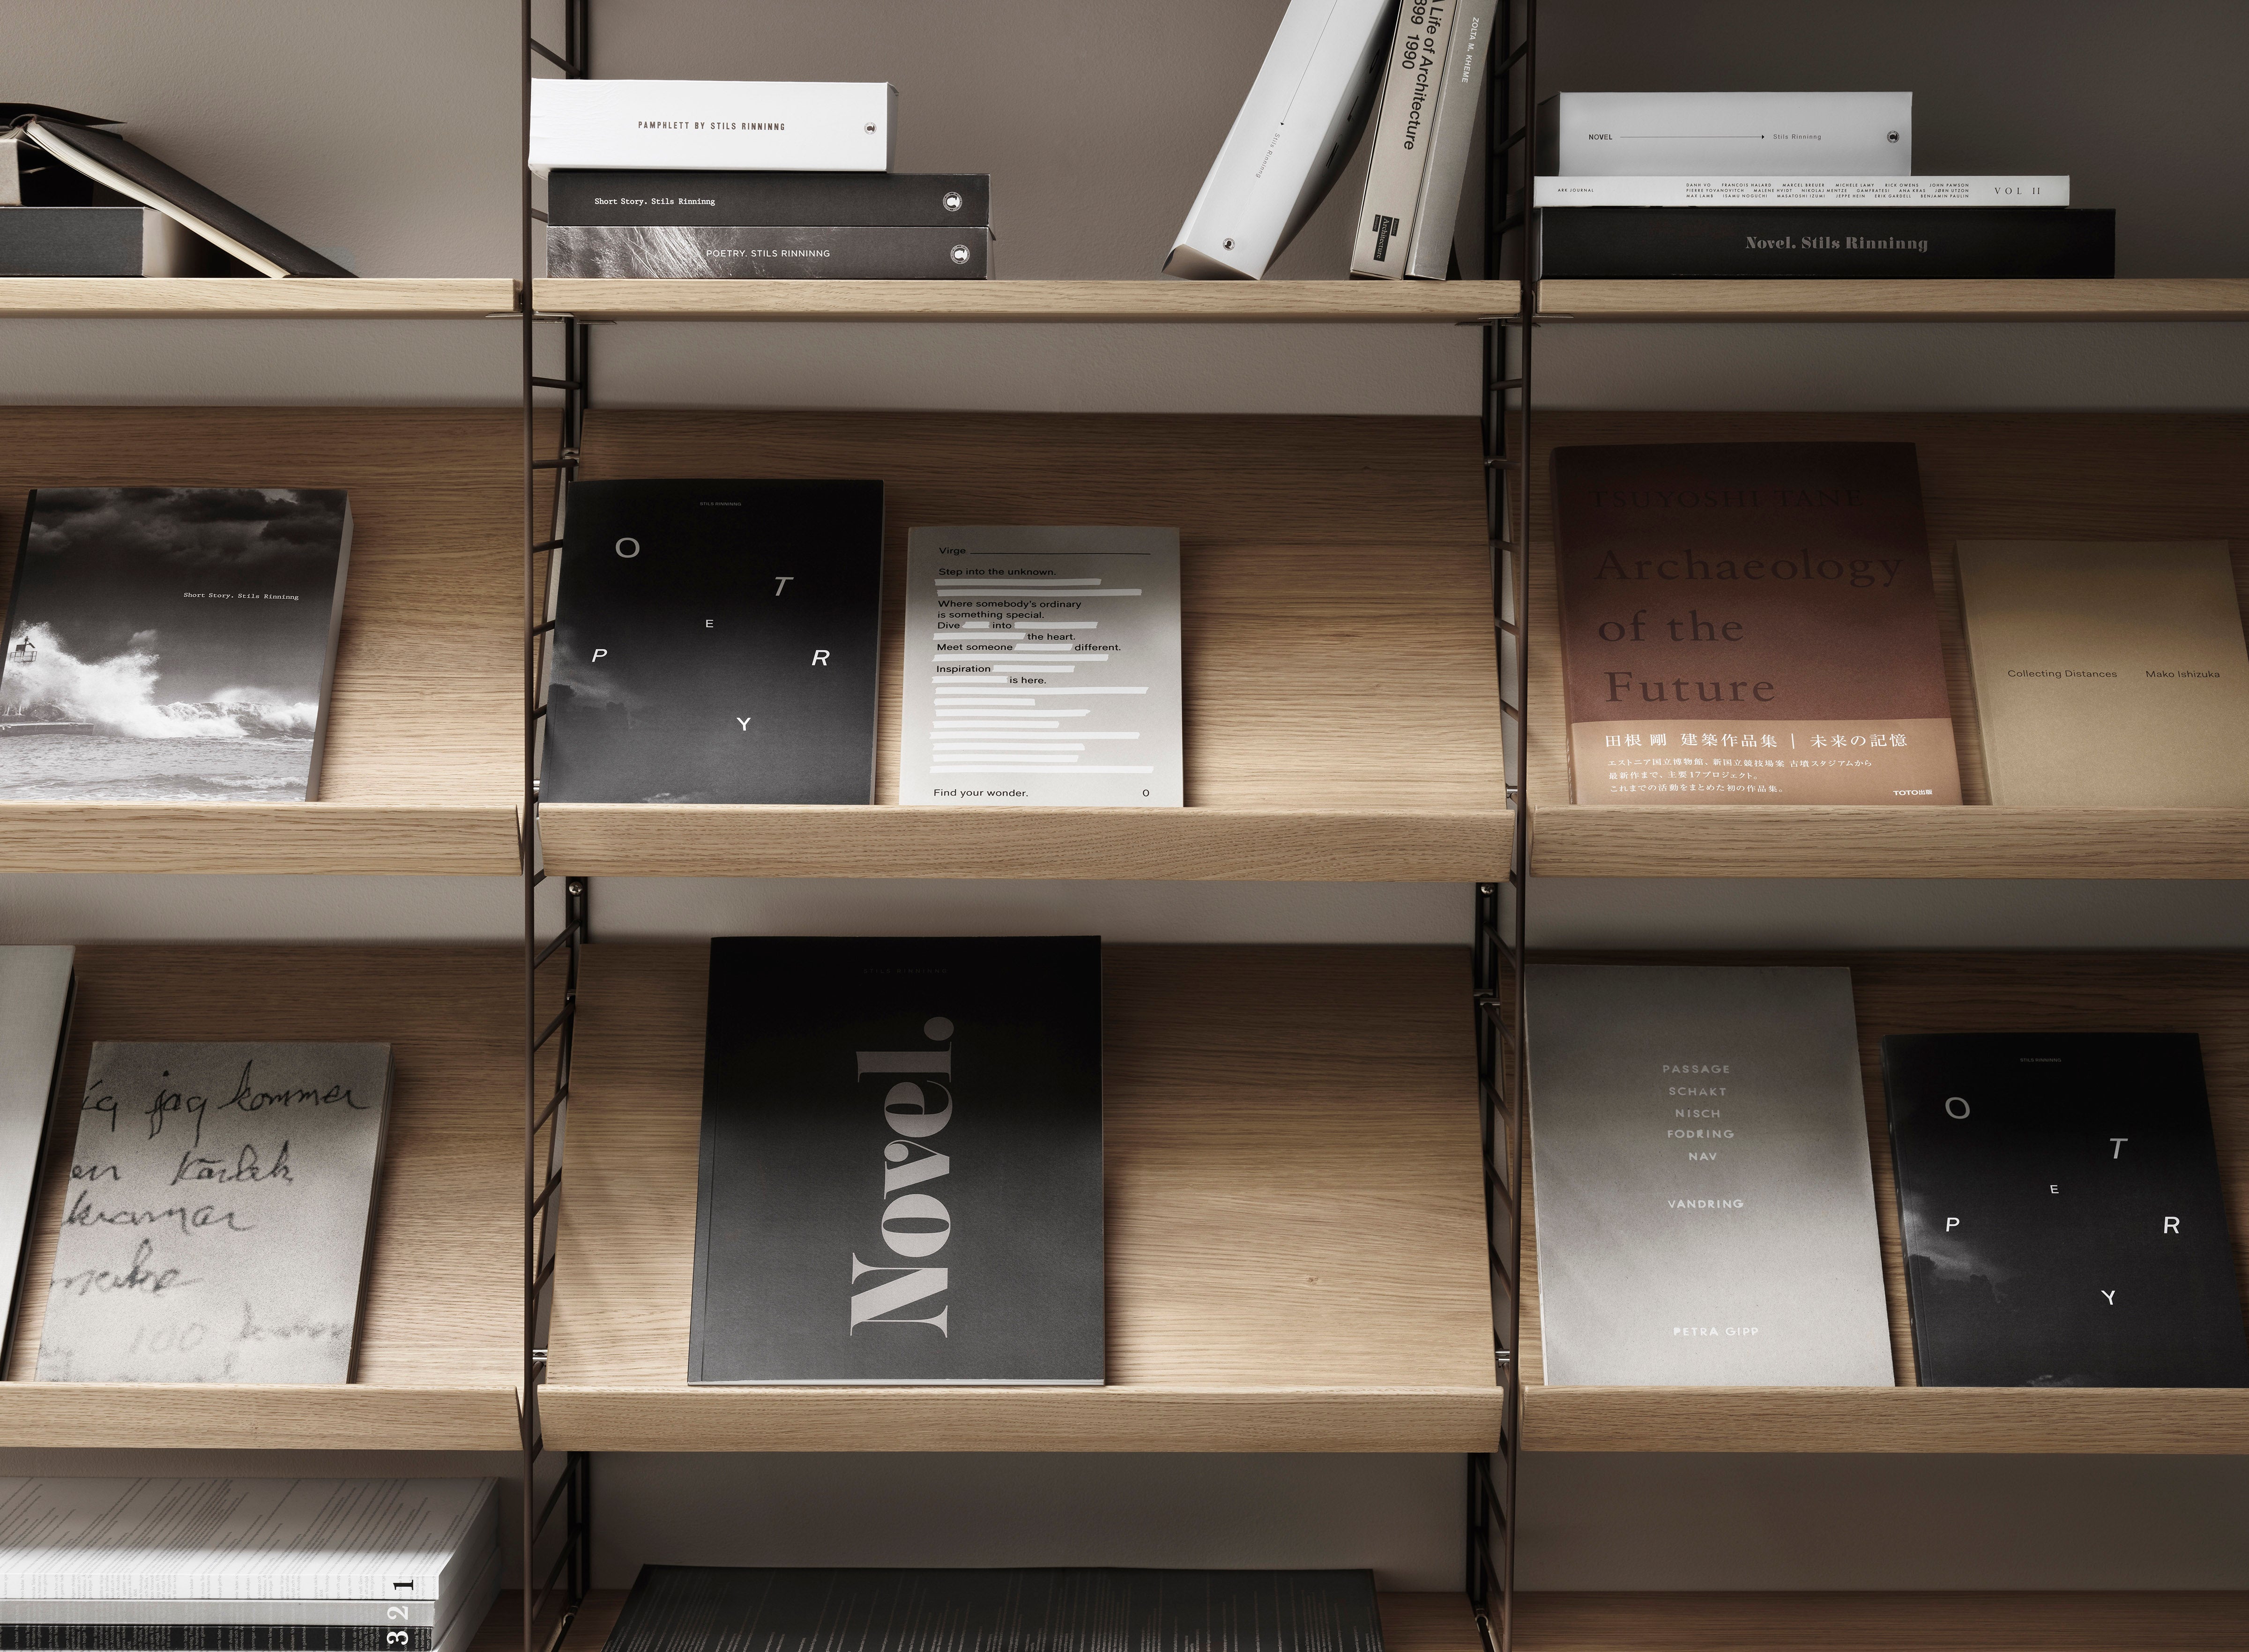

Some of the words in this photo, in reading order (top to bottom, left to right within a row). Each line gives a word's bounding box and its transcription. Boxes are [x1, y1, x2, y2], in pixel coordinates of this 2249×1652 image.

[1426, 7, 1444, 35] Life
[1469, 16, 1480, 41] ZOLTA
[1402, 34, 1420, 69] 1990
[1422, 37, 1436, 54] of
[1467, 43, 1475, 52] M.
[1461, 54, 1473, 84] KHEME
[1403, 55, 1434, 151] Architecture
[638, 121, 689, 129] PAMPHLETT
[742, 122, 784, 131] RINNINNG
[1269, 133, 1281, 148] Stils
[1255, 150, 1273, 179] Rinninng
[621, 198, 648, 206] Story.
[678, 198, 715, 206] Rinninng
[1376, 218, 1390, 259] Architecture
[1745, 236, 1796, 249] Novel.
[1802, 236, 1840, 249] Stils
[1846, 237, 1928, 253] Rinninng
[706, 249, 748, 257] POETRY.
[751, 249, 777, 258] STILS
[781, 249, 830, 258] RINNINNG
[615, 537, 640, 558] O
[939, 547, 966, 556] Virge
[938, 568, 962, 577] Step
[1593, 548, 1905, 588] Archaeology
[775, 576, 794, 596] T
[976, 600, 1037, 610] somebody's
[1040, 601, 1081, 610] ordinary
[949, 611, 1003, 620] something
[1006, 611, 1044, 620] special.
[706, 619, 714, 628] E
[1598, 609, 1647, 642] of
[1666, 609, 1744, 642] the
[592, 648, 608, 662] P
[812, 649, 830, 666] R
[937, 665, 990, 674] Inspiration
[2008, 670, 2062, 679] Collecting
[1603, 671, 1776, 703] Future
[736, 717, 751, 731] Y
[1680, 733, 1778, 748] 建築作品集
[1810, 733, 1908, 748] 未来の記憶
[1663, 1065, 1729, 1073] PASSAGE
[217, 1059, 372, 1112] kommer
[1669, 1086, 1726, 1096] SCHAKT
[1676, 1109, 1720, 1118] NISCH
[1945, 1097, 1970, 1119] O
[2109, 1138, 2129, 1159] T
[1689, 1152, 1717, 1161] NAV
[850, 1016, 954, 1338] Novel.
[2050, 1185, 2059, 1194] E
[1668, 1199, 1744, 1208] VANDRING
[1946, 1217, 1960, 1232] P
[2164, 1216, 2180, 1234] R
[2100, 1290, 2115, 1305] Y
[1673, 1327, 1719, 1336] PETRA
[1725, 1327, 1758, 1336] GIPP
[392, 1579, 414, 1591] 1
[387, 1605, 409, 1620] 2
[386, 1630, 409, 1645] 3
